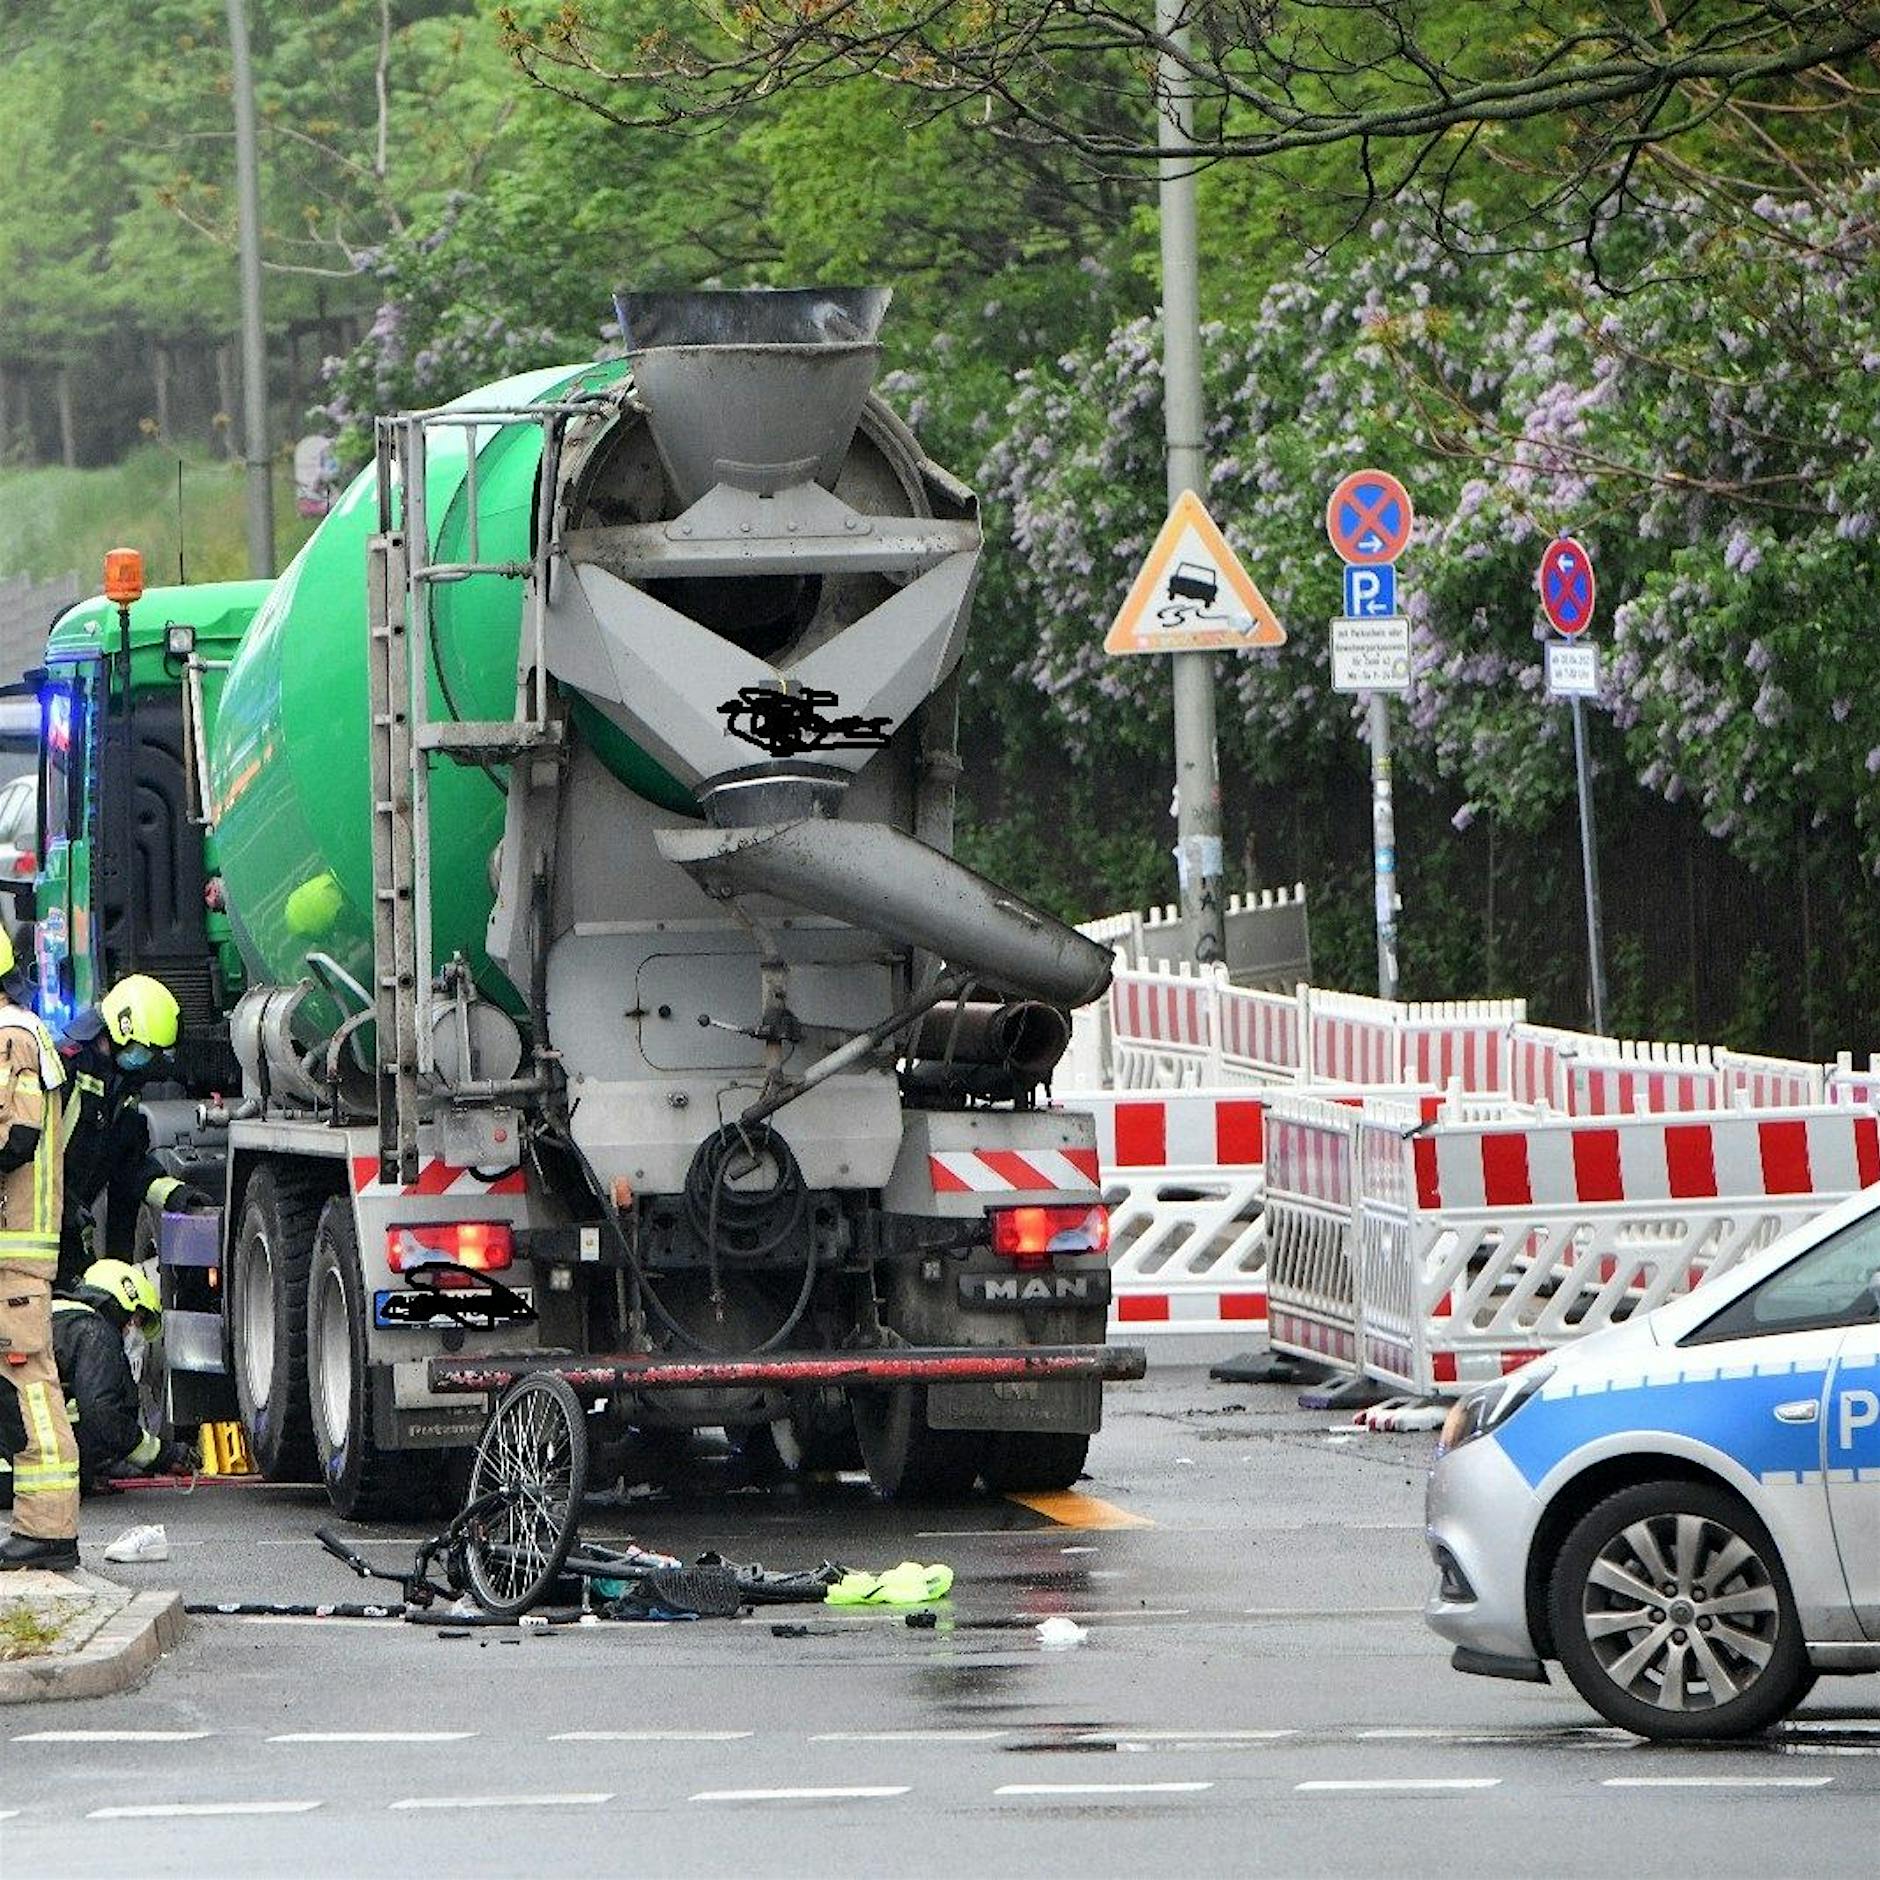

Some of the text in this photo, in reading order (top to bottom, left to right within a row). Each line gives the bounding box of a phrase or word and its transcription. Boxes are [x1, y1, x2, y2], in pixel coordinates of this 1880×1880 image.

[1352, 571, 1380, 616] P
[985, 1277, 1088, 1300] MAN
[1840, 1390, 1879, 1449] P
